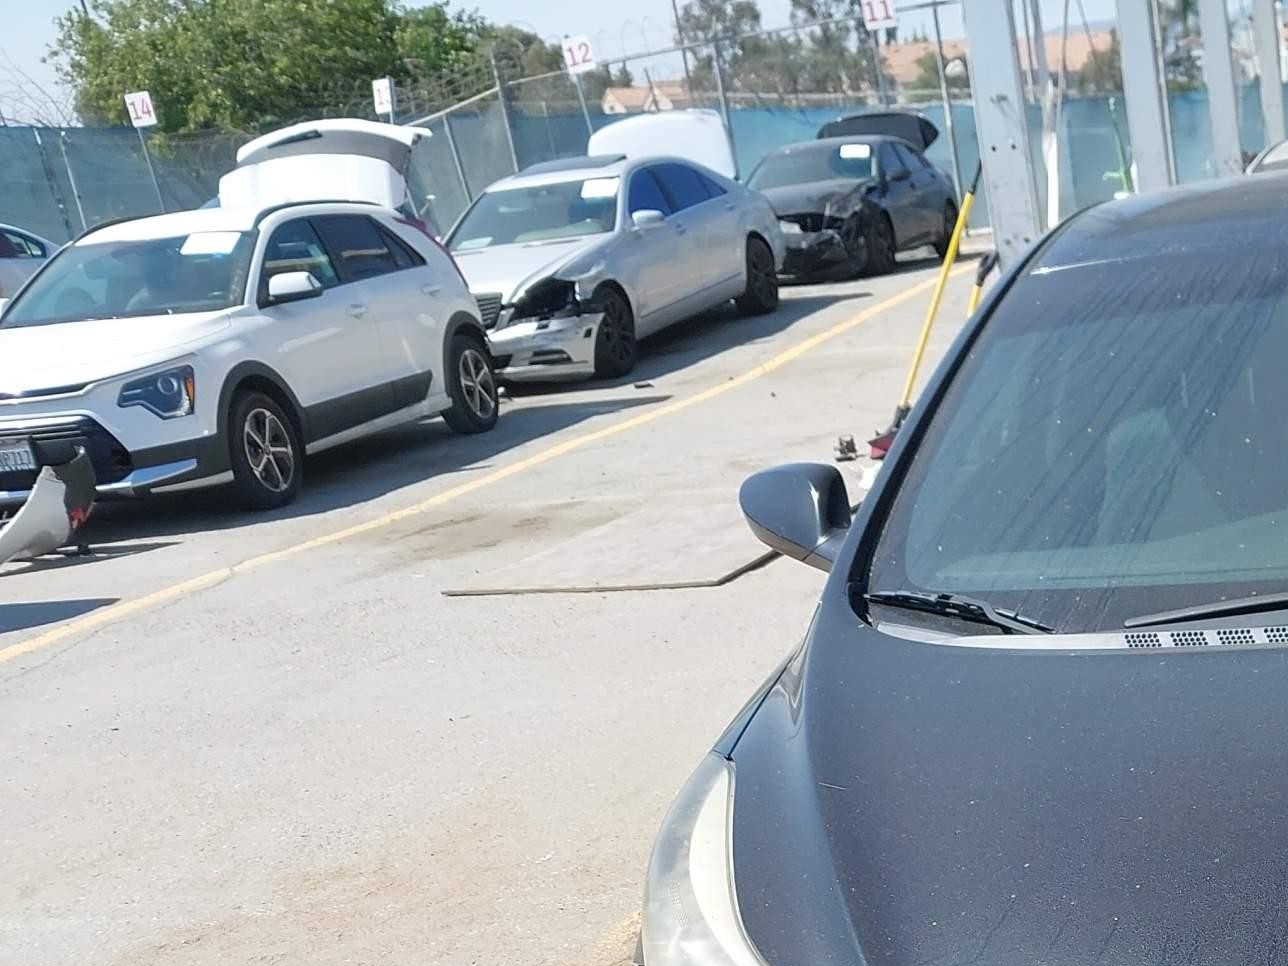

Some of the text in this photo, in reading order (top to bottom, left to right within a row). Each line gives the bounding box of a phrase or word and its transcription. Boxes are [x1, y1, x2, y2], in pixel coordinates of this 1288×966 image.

[866, 0, 893, 21] 11
[566, 42, 592, 67] 12
[129, 98, 153, 120] 14
